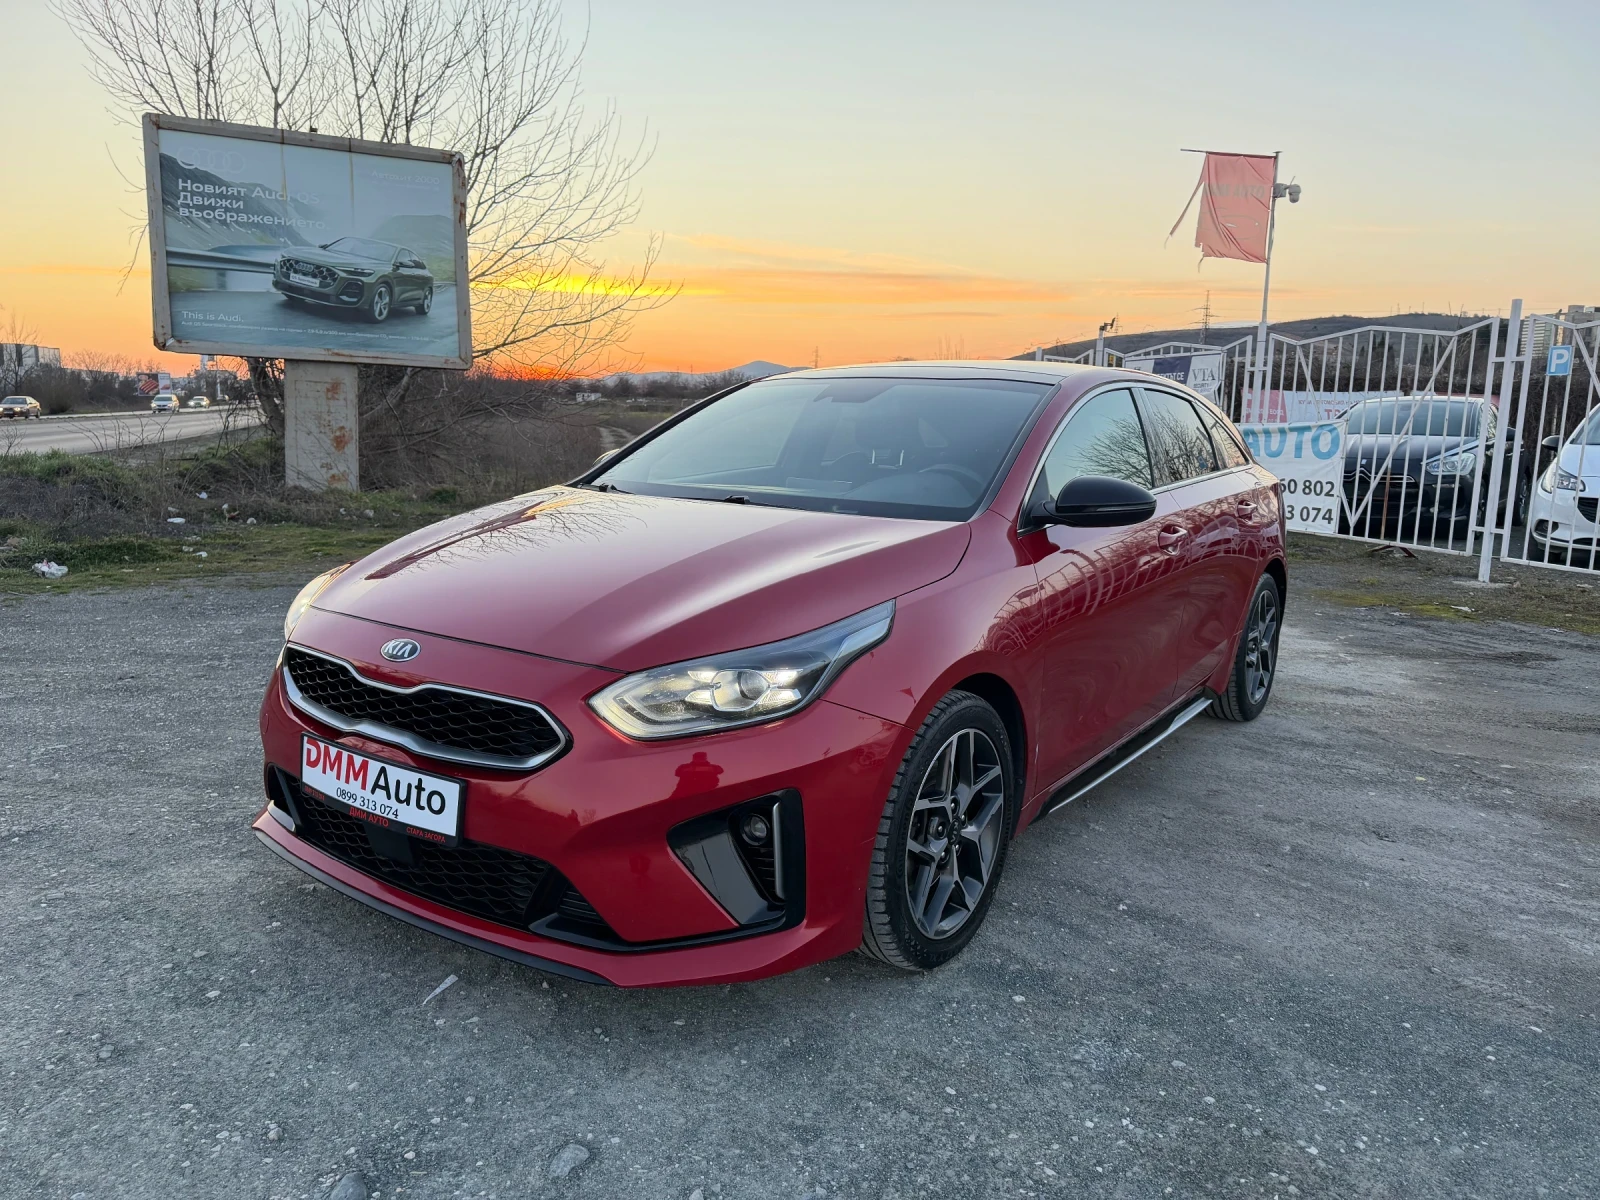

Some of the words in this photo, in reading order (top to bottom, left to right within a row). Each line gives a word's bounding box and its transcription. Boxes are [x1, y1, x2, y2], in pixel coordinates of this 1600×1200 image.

[415, 175, 440, 185] 2000
[178, 178, 246, 197] Новият
[252, 187, 290, 202] Audi
[177, 192, 243, 209] Движи
[181, 310, 204, 320] This
[206, 312, 215, 320] is
[1550, 349, 1569, 373] P
[1191, 368, 1216, 381] VTA
[1243, 424, 1340, 460] AUTO
[1301, 479, 1335, 498] 802
[1299, 506, 1334, 525] 074
[384, 640, 413, 658] KIA
[336, 787, 358, 804] 0899
[359, 795, 377, 812] 313
[379, 803, 399, 819] 074
[349, 807, 367, 819] ДММ
[368, 814, 390, 828] АУТО
[406, 826, 424, 837] СТАРА
[424, 831, 446, 843] ЗАГОРА
